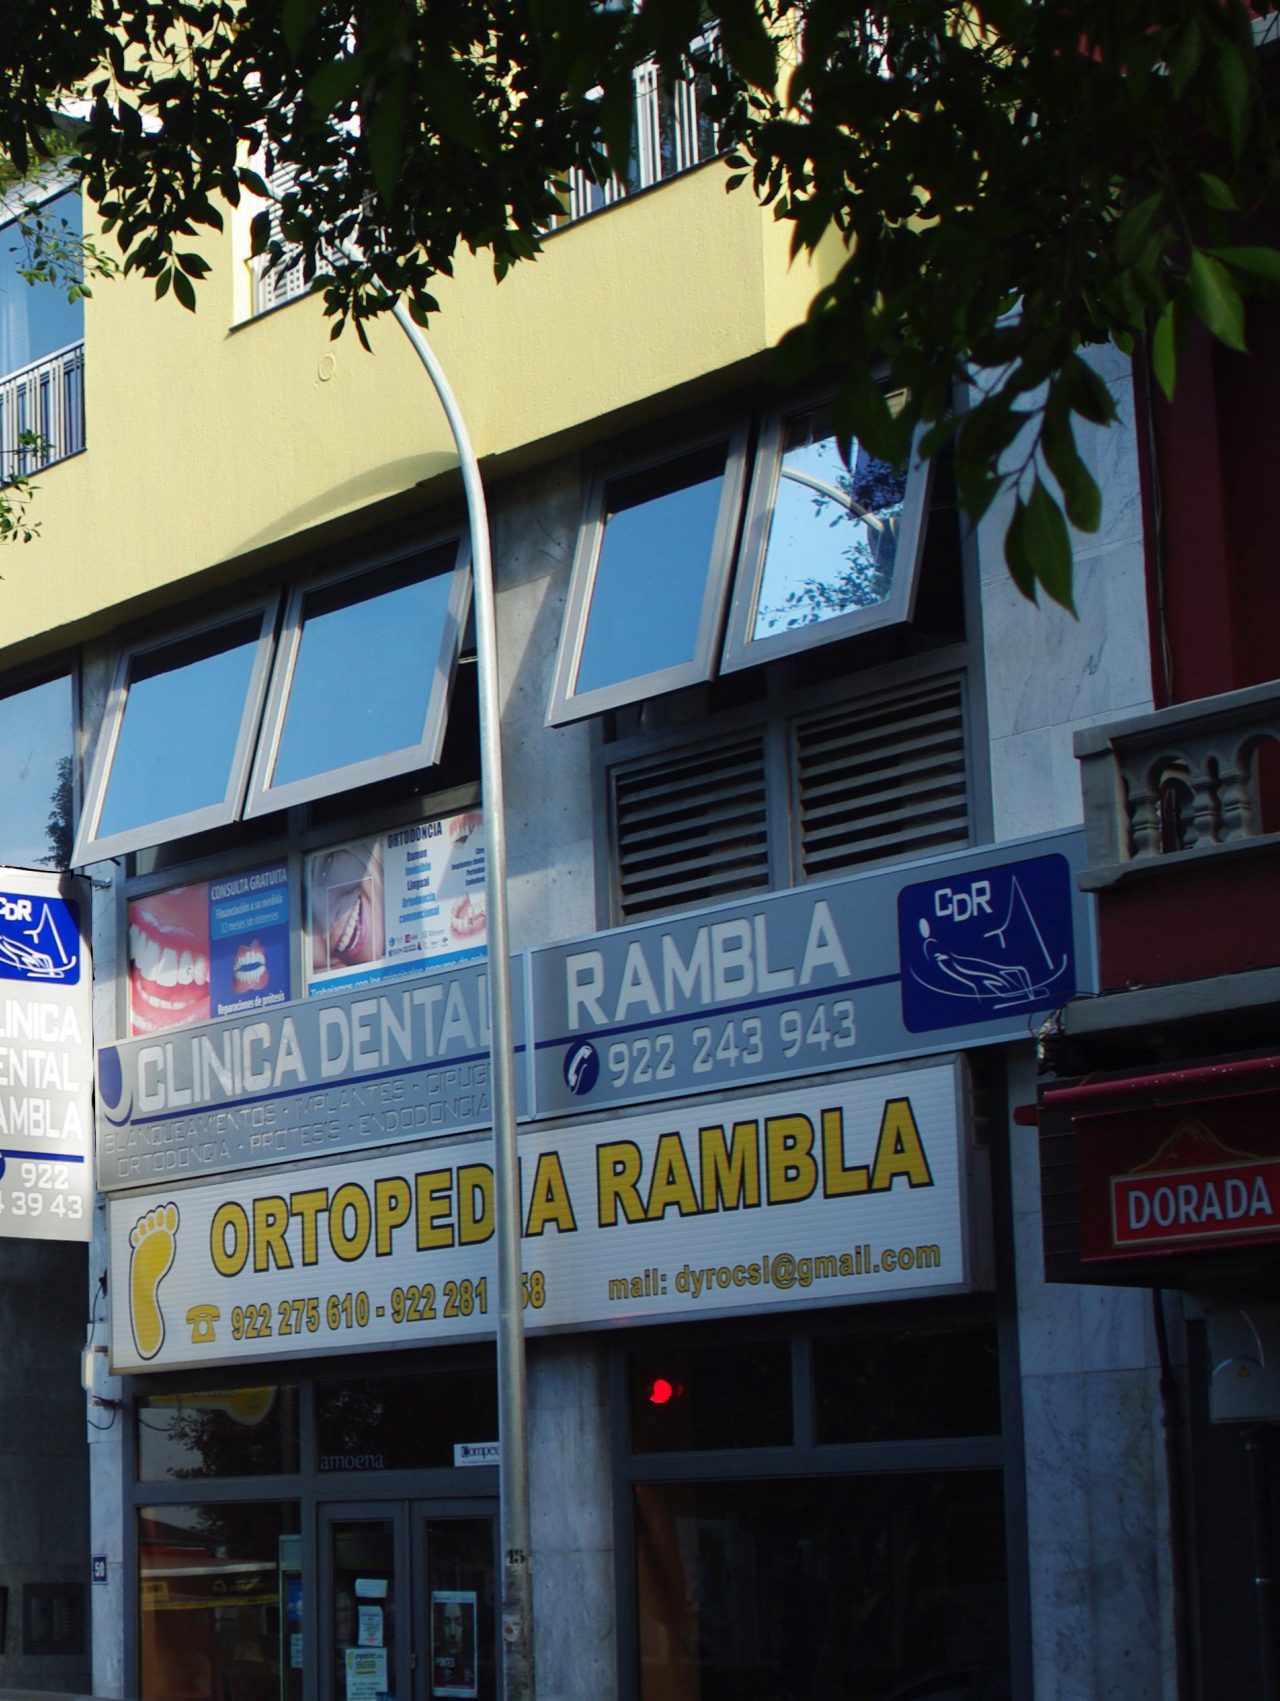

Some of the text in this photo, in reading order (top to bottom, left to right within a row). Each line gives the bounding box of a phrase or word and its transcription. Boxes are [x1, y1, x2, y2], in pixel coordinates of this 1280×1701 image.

[387, 821, 442, 848] ORTODONCIA
[211, 868, 287, 900] CONSULTA GRATUITA
[934, 880, 992, 922] CDR
[565, 901, 851, 1030] RAMBLA
[137, 1016, 307, 1113] CLINICA
[607, 1000, 857, 1088] 922 243 943
[104, 1104, 276, 1154] BLANQUEAMIENTOS
[295, 1079, 405, 1119] IMPLANTES
[118, 1093, 489, 1177] ORTODONCIA PROTESIS ENDODONCIA
[21, 1161, 69, 1190] 922
[210, 1097, 934, 1278] ORTOPEDA RAMBLA
[11, 1192, 42, 1216] 39
[49, 1194, 83, 1219] 43
[1128, 1176, 1274, 1231] DORADA
[231, 1303, 272, 1340] 922
[278, 1295, 320, 1336] 275
[326, 1290, 370, 1331] 610
[391, 1284, 436, 1323] 922
[442, 1277, 487, 1317] 281
[608, 1268, 667, 1300] mail:
[320, 1454, 385, 1470] amoena
